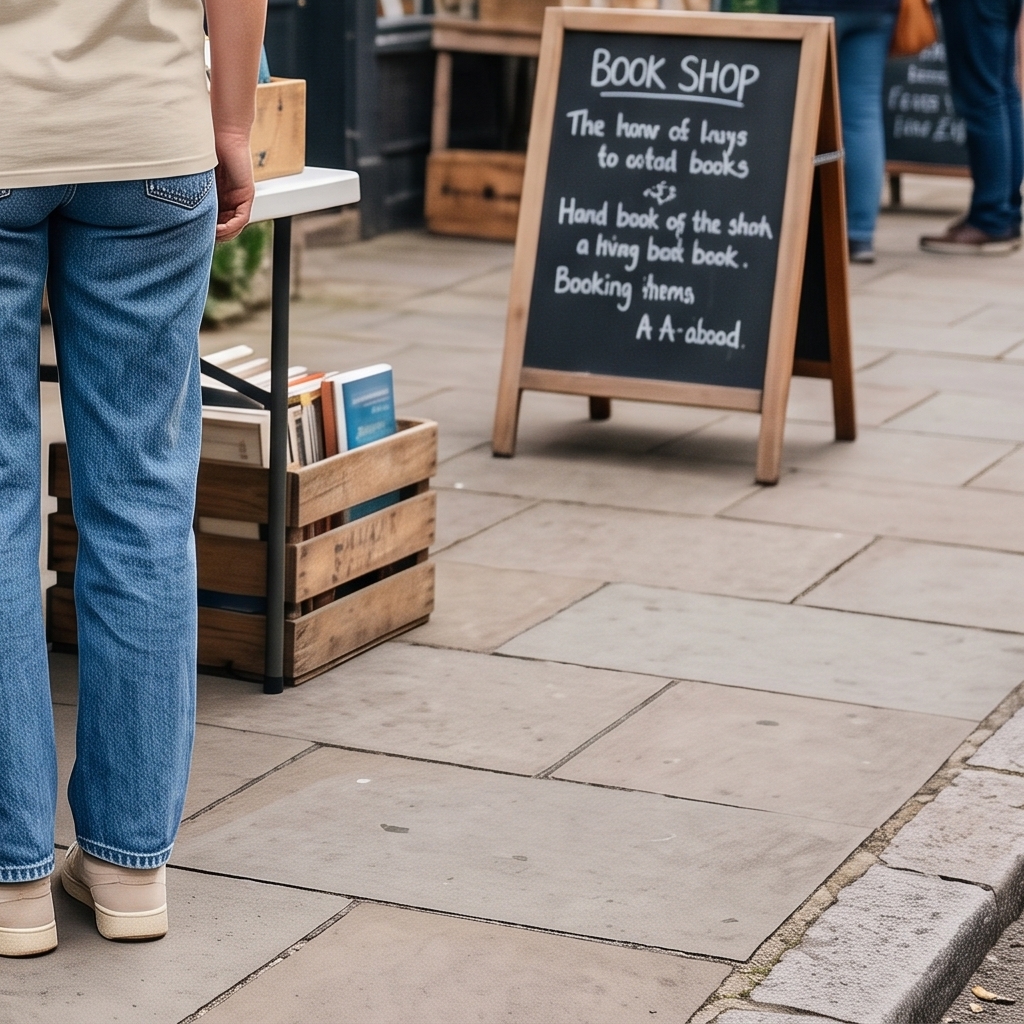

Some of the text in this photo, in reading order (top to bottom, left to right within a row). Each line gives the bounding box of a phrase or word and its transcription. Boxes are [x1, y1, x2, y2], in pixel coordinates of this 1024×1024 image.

[590, 47, 761, 103] BOOK SHOP
[566, 108, 606, 138] The
[597, 143, 620, 169] to
[689, 148, 750, 180] books
[558, 196, 609, 227] Hand
[616, 201, 660, 231] book
[666, 212, 687, 240] of
[692, 209, 723, 236] the
[576, 237, 590, 256] a
[554, 264, 633, 313] Booking
[635, 312, 654, 341] A
